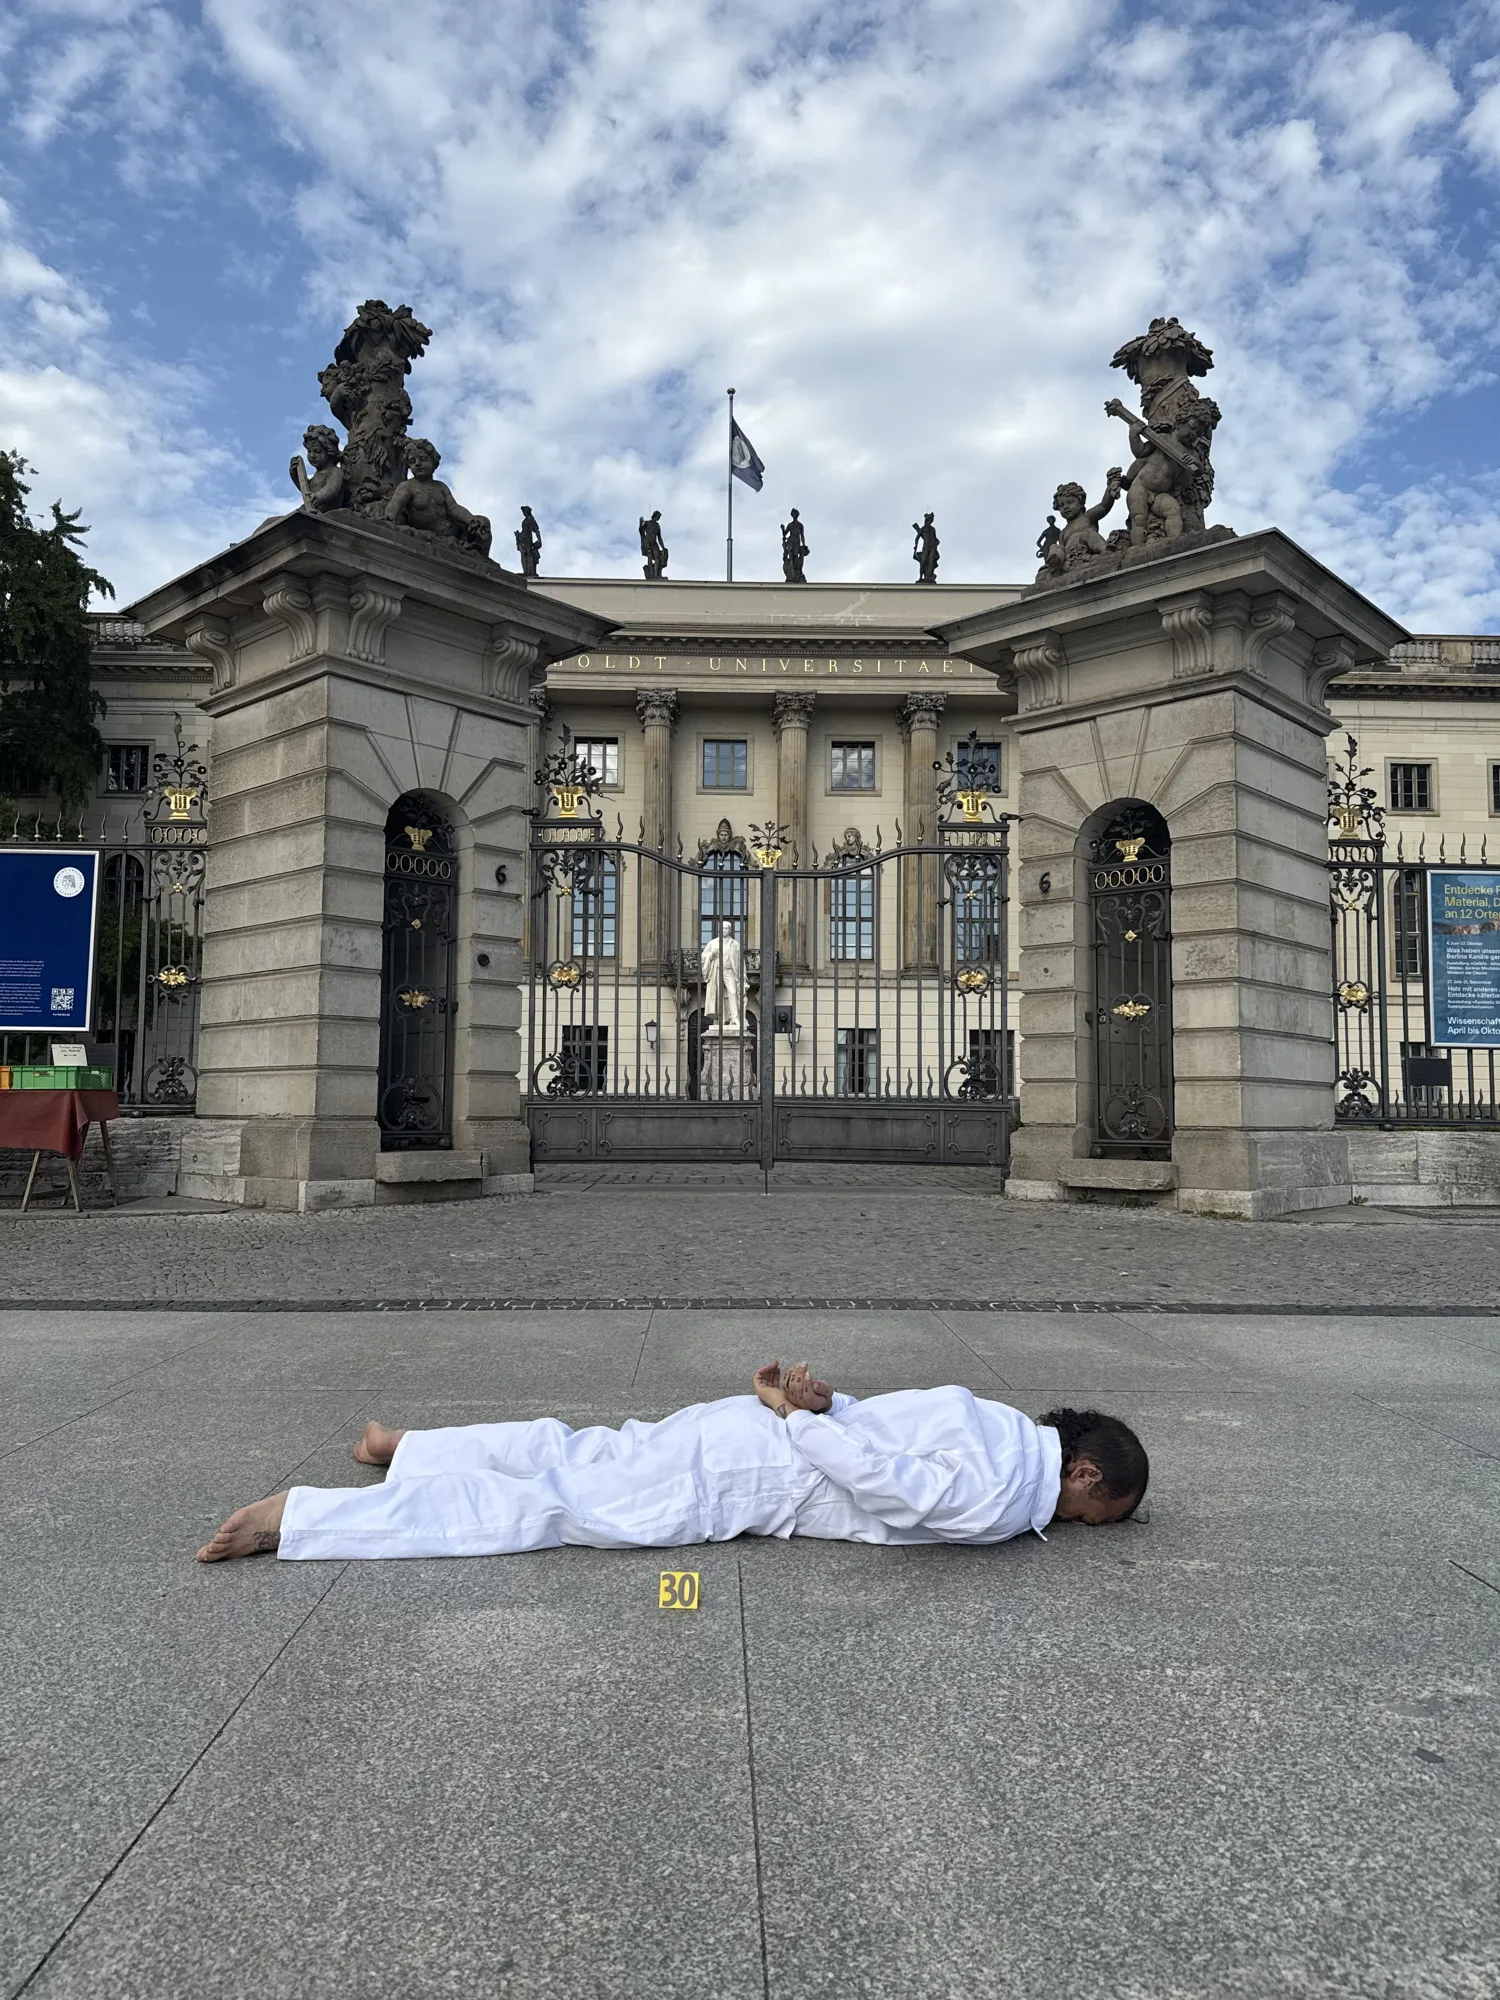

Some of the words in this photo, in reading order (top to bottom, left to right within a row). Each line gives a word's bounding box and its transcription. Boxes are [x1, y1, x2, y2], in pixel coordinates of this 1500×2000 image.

[495, 864, 507, 885] 6
[1039, 871, 1051, 893] 6
[1444, 884, 1494, 895] Entdecke
[1444, 896, 1491, 908] Material,
[1444, 910, 1458, 919] an
[1460, 908, 1473, 919] 12
[1474, 908, 1500, 919] Orte
[1447, 1026, 1466, 1036] April
[1467, 1026, 1480, 1035] bis
[1480, 1026, 1500, 1035] Okto
[662, 1573, 696, 1607] 30
